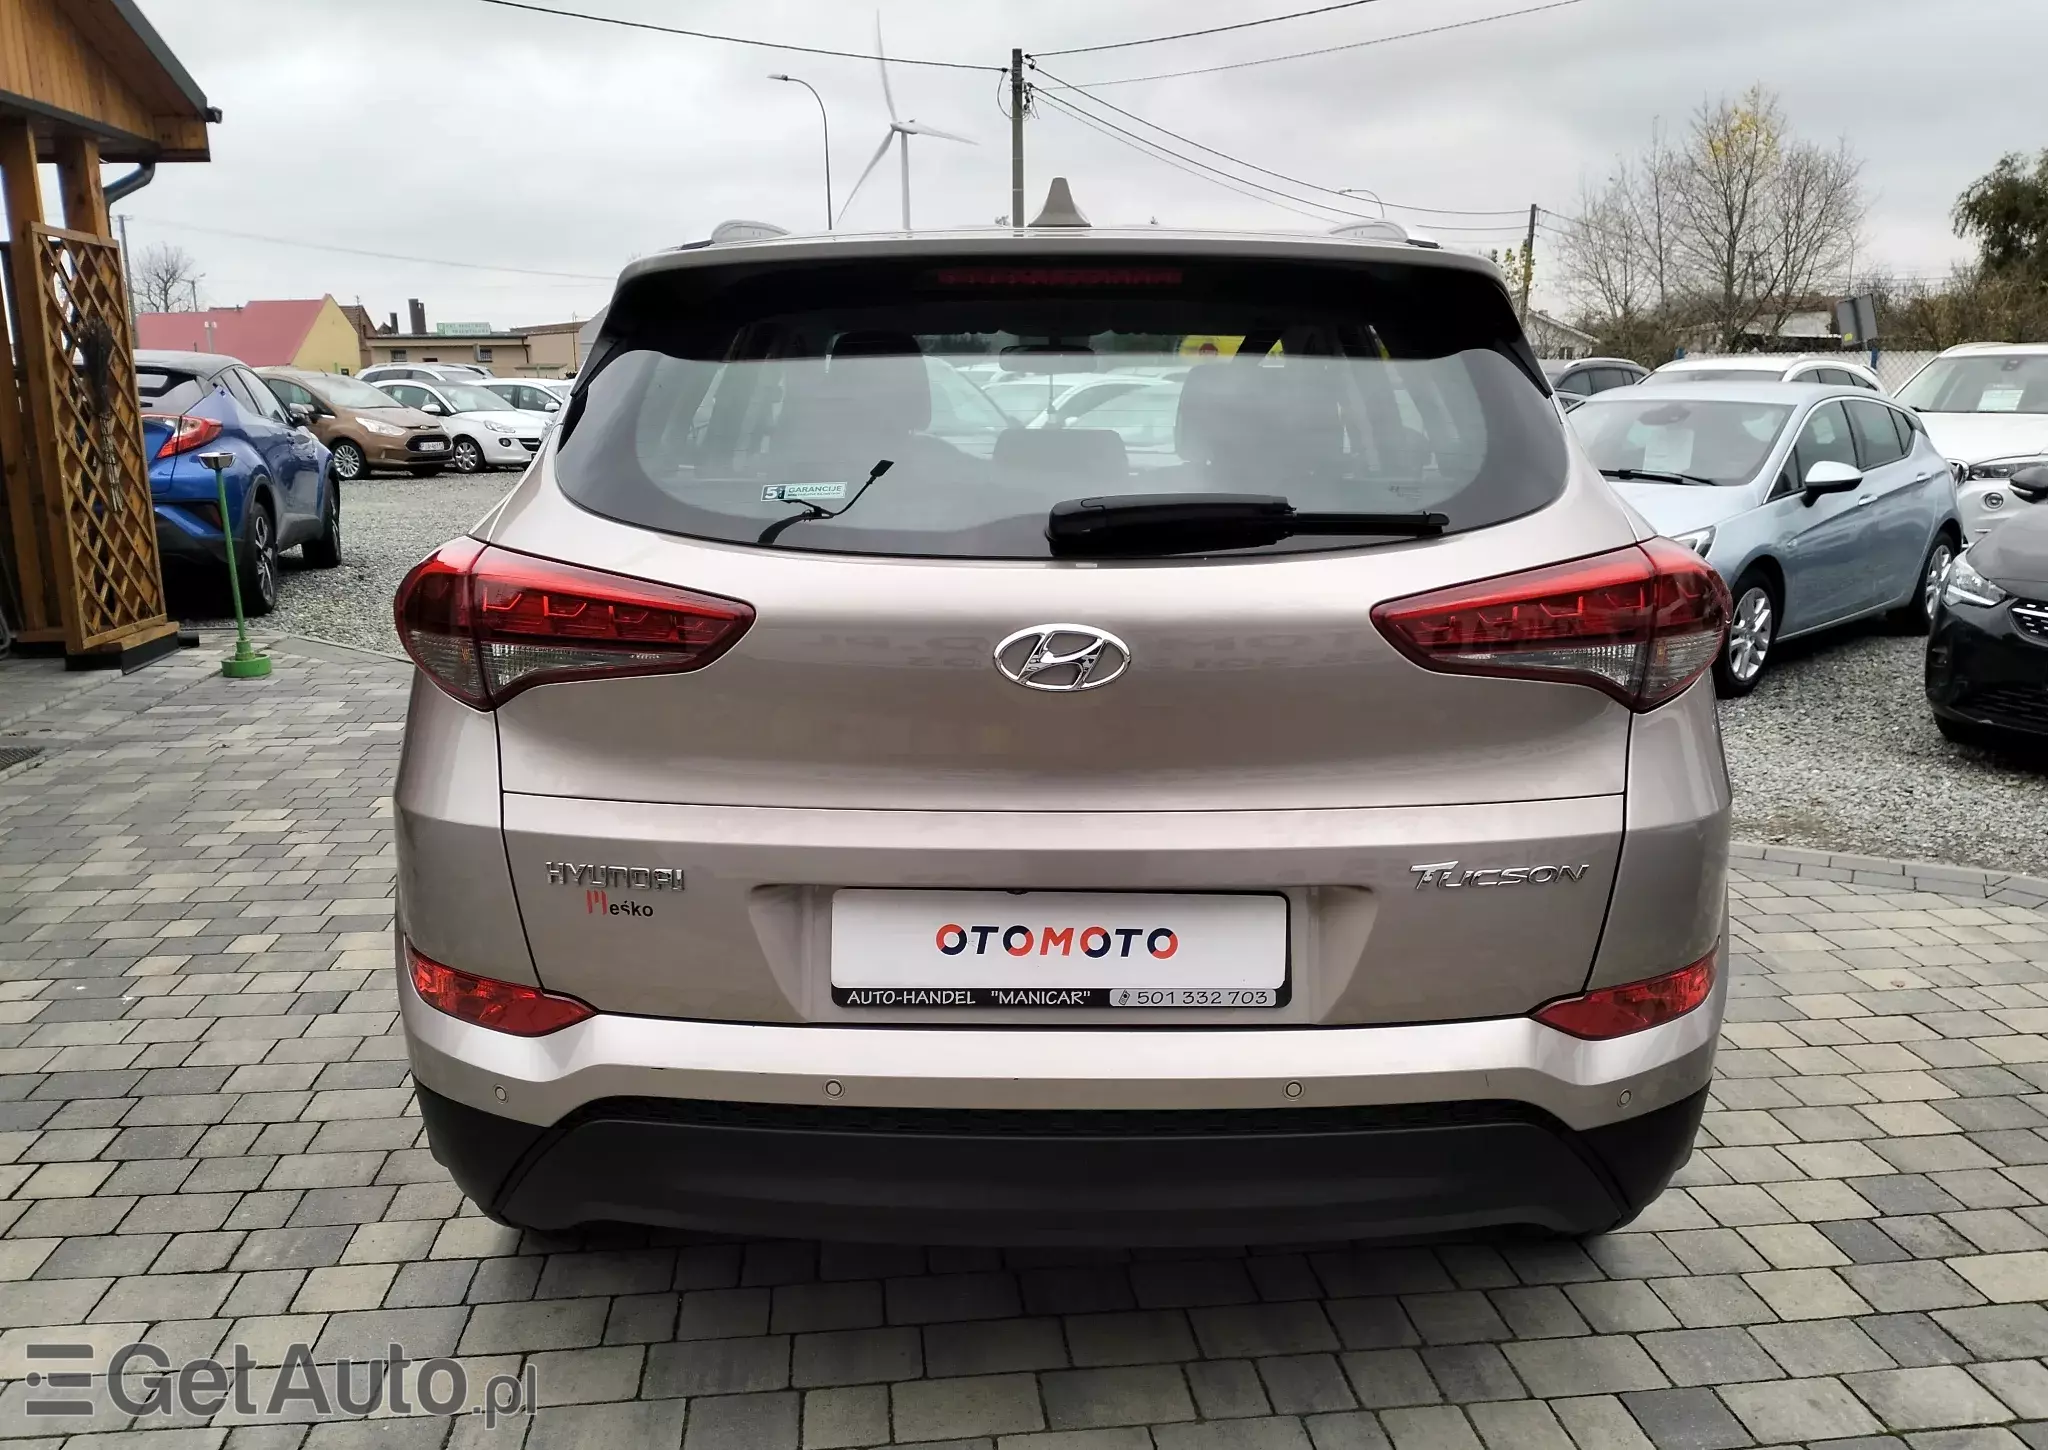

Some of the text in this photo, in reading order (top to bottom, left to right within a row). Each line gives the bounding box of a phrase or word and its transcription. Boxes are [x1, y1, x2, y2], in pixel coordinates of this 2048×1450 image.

[764, 487, 779, 499] 5
[545, 861, 685, 891] HYUNDAI
[1410, 861, 1590, 890] TUCSON
[586, 890, 654, 917] Meśko
[935, 923, 1179, 960] OTOMOTO
[847, 990, 1268, 1006] AUTO-HANDEL "MANICAR" 501 332 703
